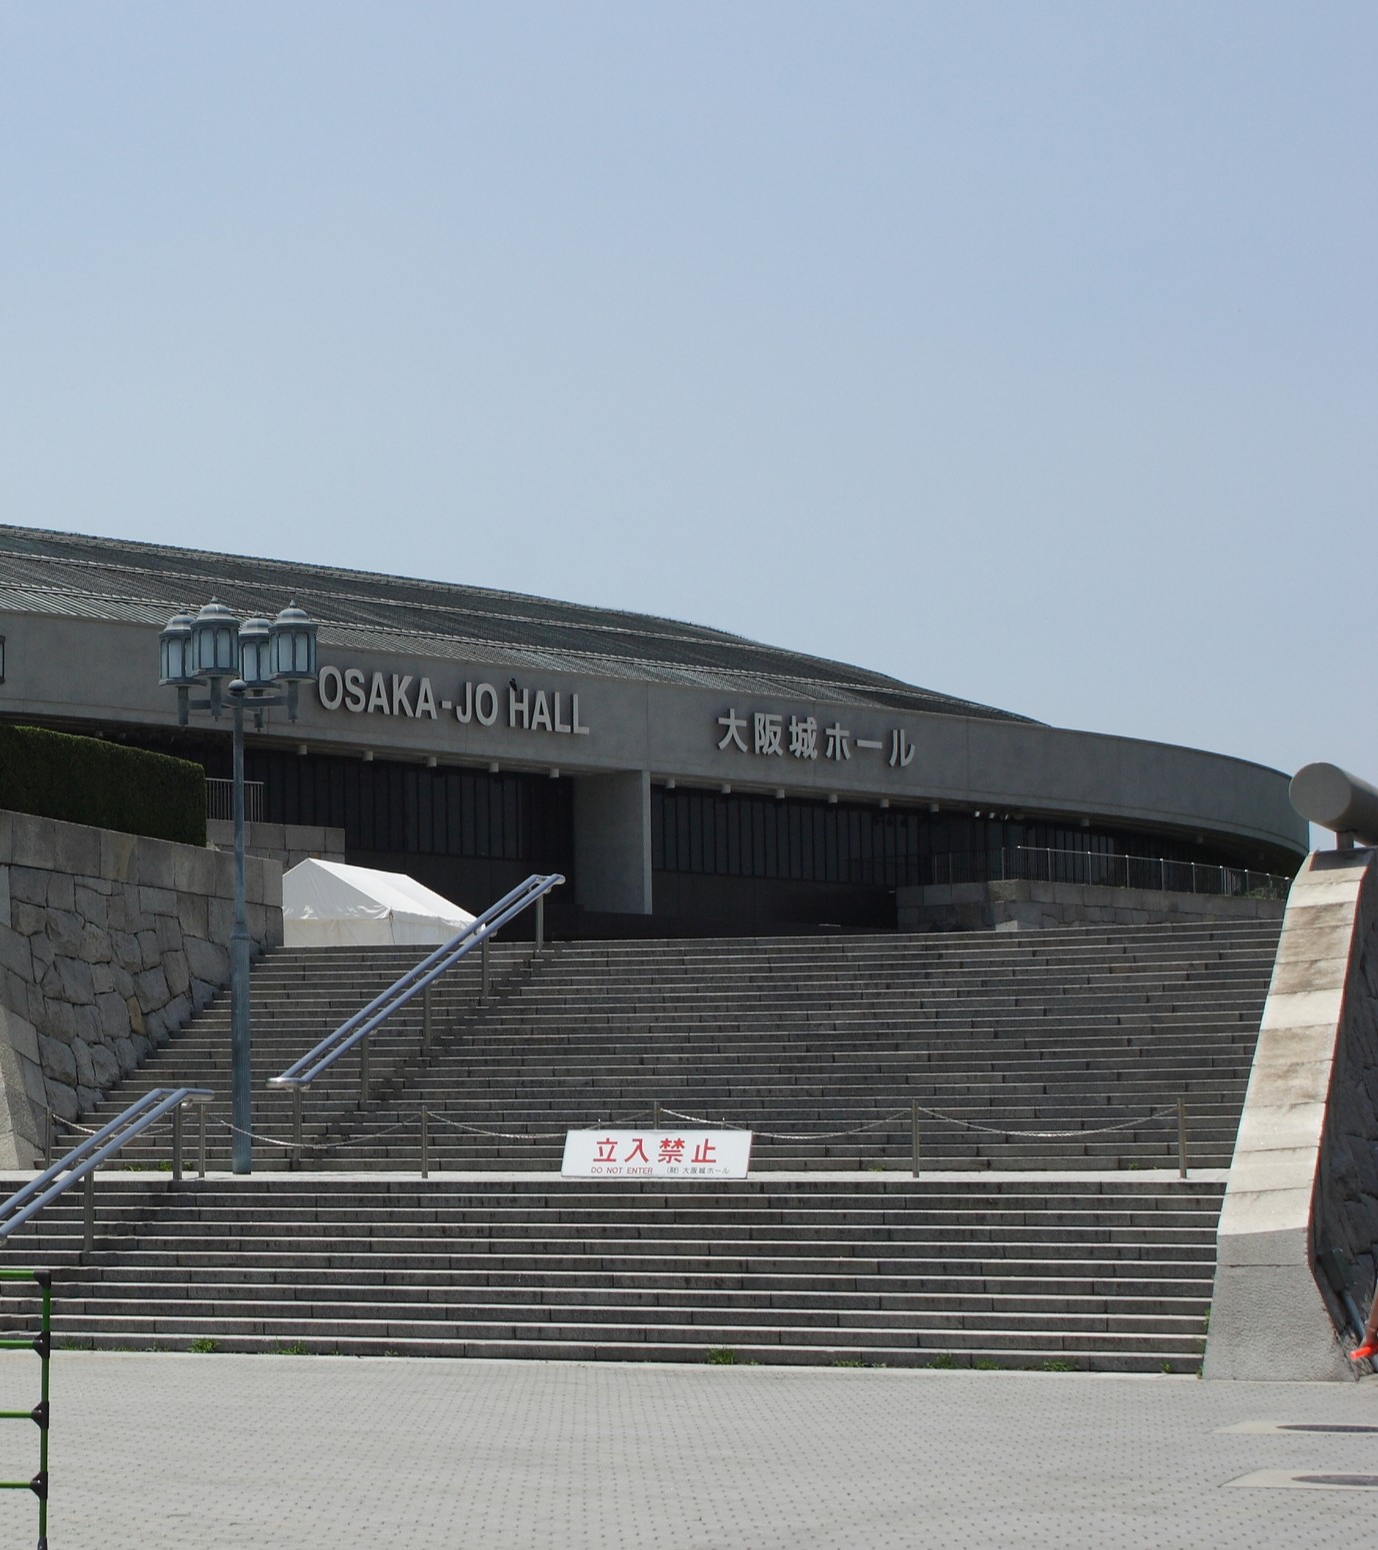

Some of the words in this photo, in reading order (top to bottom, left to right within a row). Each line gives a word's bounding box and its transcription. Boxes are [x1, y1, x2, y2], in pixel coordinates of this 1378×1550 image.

[318, 665, 499, 727] OSAKA-JO
[509, 687, 590, 735] HALL
[718, 708, 916, 767] 大阪城ホール
[593, 1138, 717, 1163] 立入禁止
[591, 1166, 603, 1174] DO
[606, 1166, 623, 1174] NOT
[626, 1166, 654, 1175] ENTER
[682, 1166, 730, 1175] 大阪城ホール
